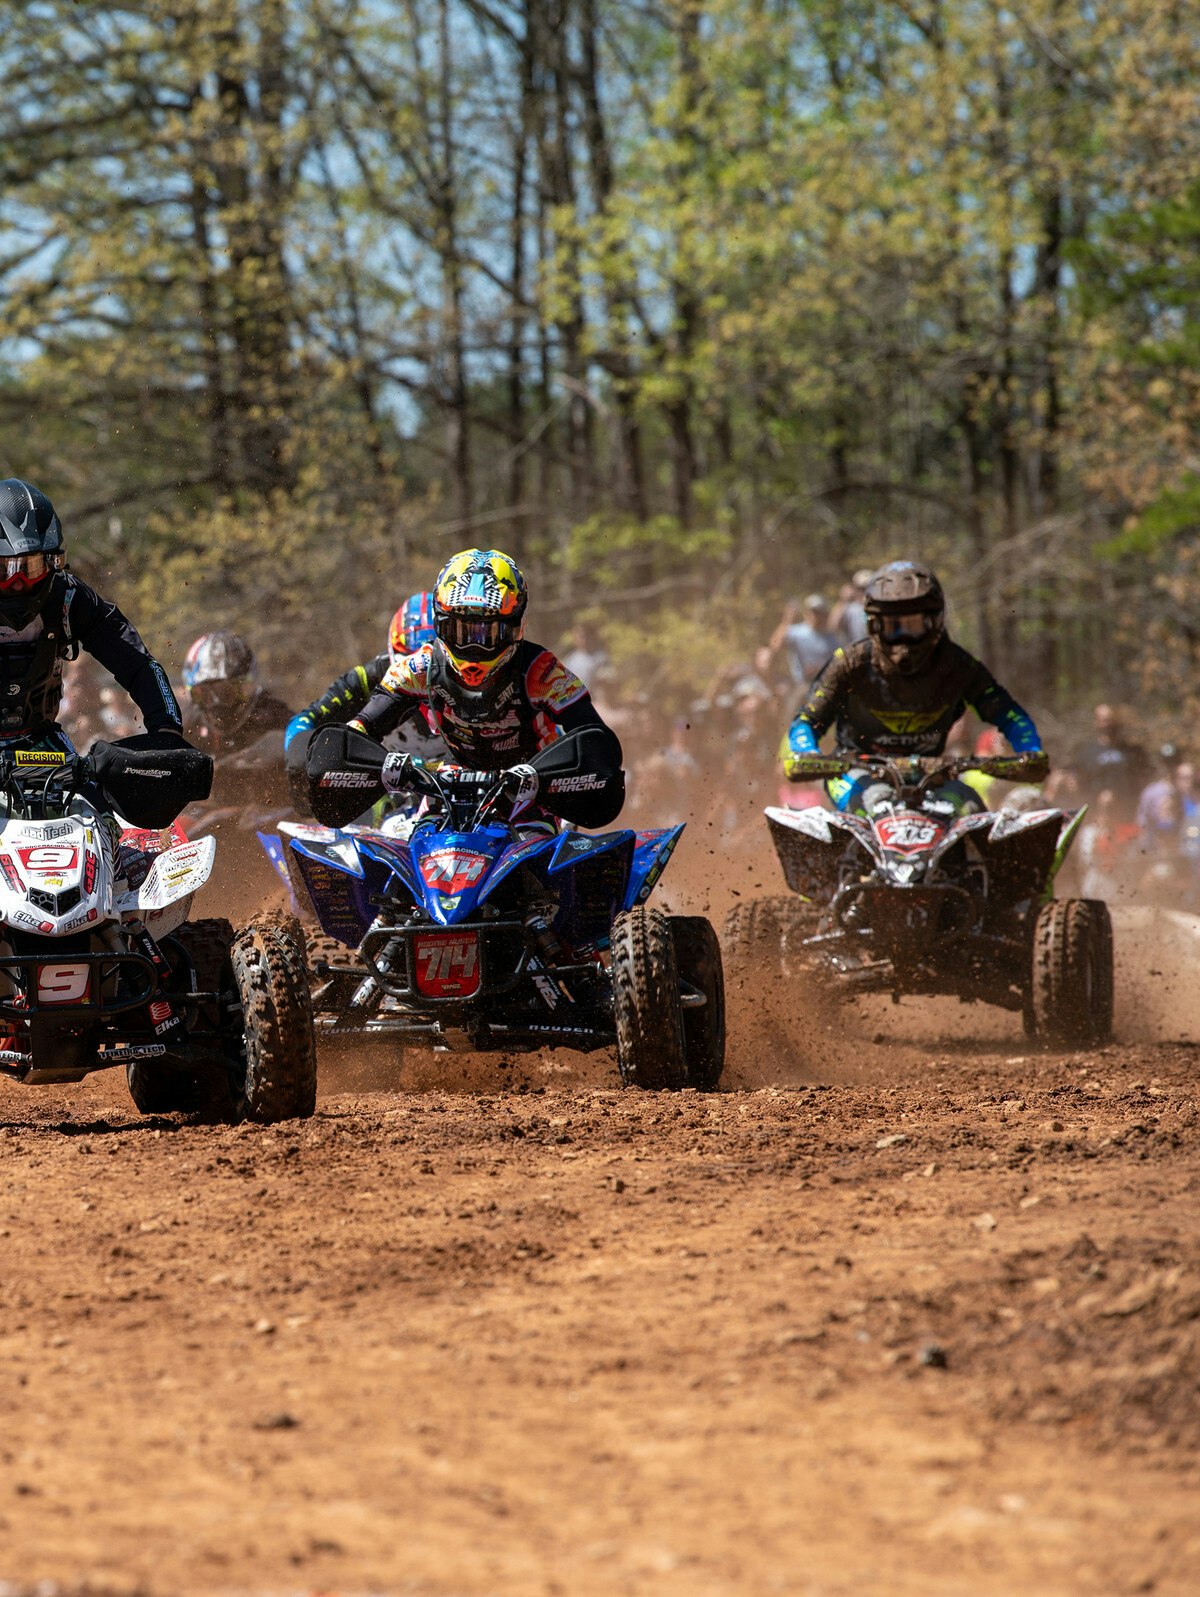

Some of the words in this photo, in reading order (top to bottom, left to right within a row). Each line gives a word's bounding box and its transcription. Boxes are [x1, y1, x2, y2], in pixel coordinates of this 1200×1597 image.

[323, 771, 369, 780] MOOSE
[329, 780, 378, 788] RACING
[551, 774, 597, 786] MOOSE
[557, 780, 606, 793] RACING
[26, 848, 75, 869] 9
[84, 849, 97, 895] GBC
[425, 856, 484, 882] 714
[14, 911, 41, 926] Elka
[64, 915, 88, 932] Elka
[142, 938, 156, 956] Elka
[418, 944, 478, 981] 714
[38, 964, 90, 1002] 9
[154, 1016, 180, 1035] Elka
